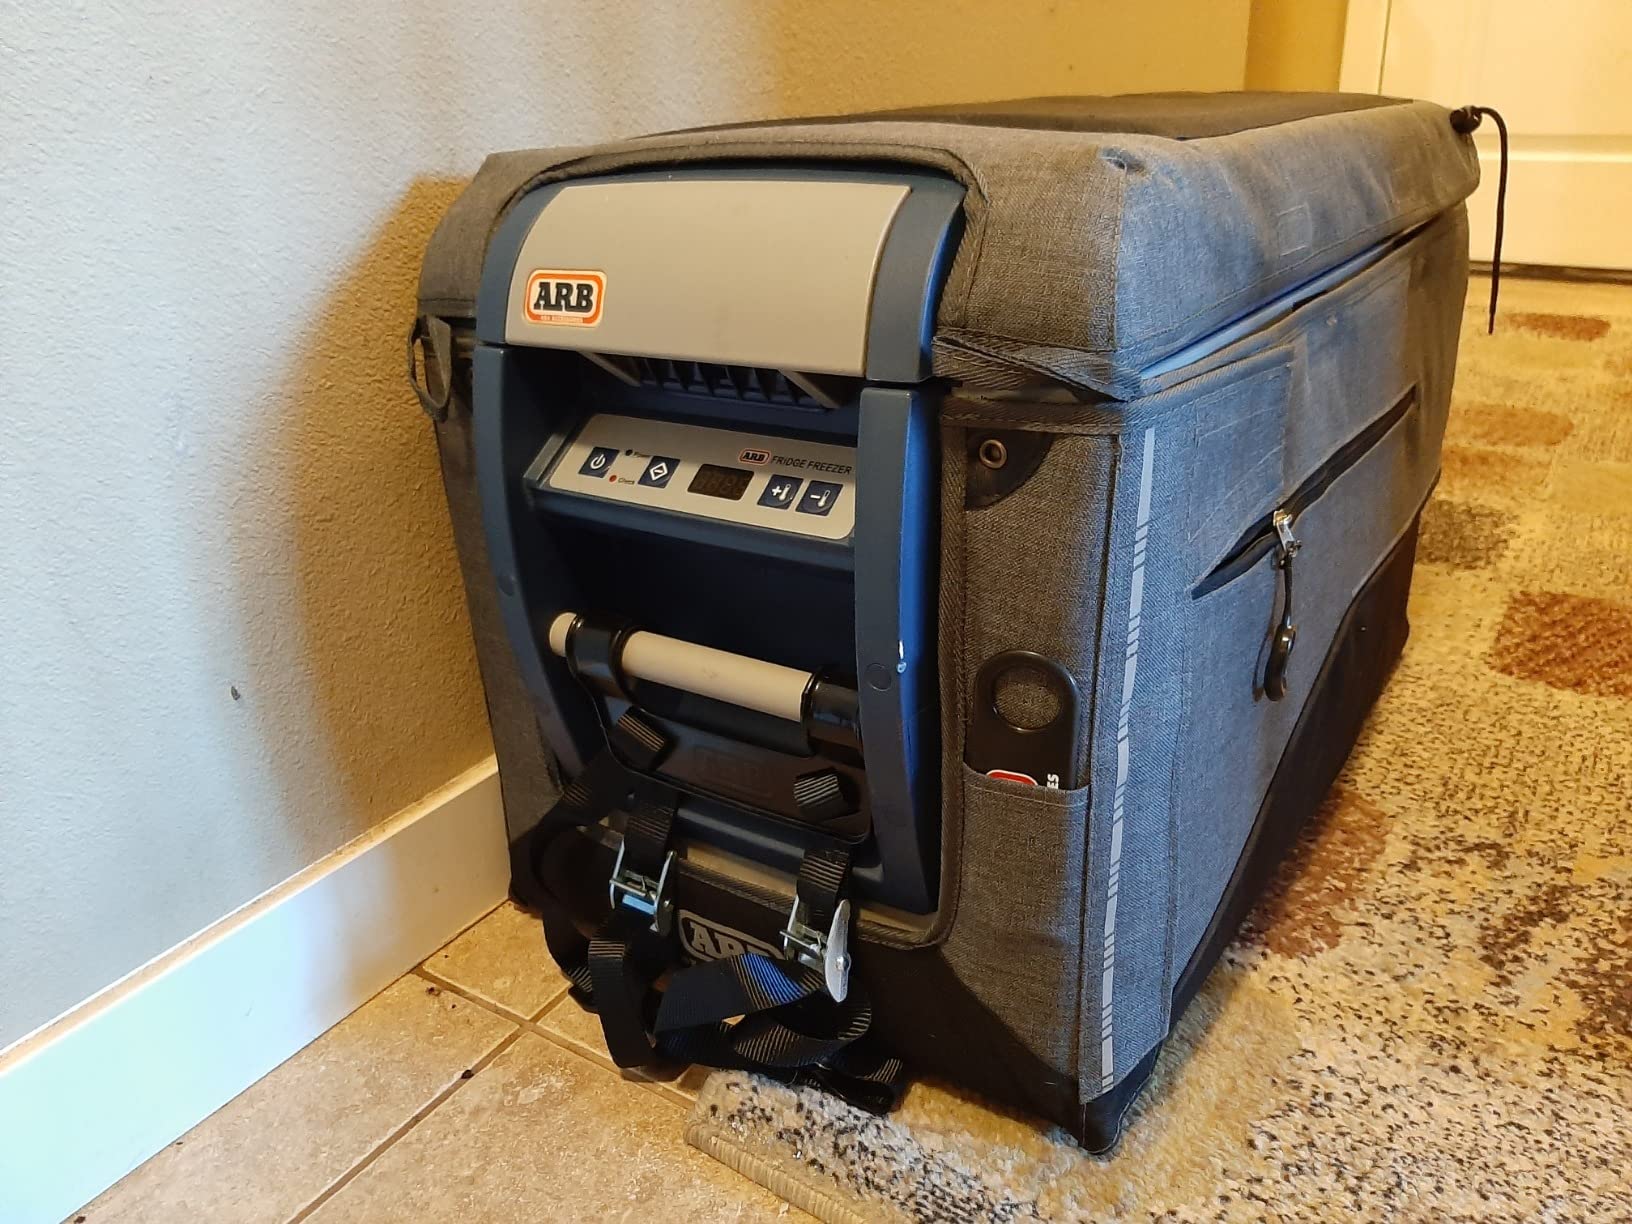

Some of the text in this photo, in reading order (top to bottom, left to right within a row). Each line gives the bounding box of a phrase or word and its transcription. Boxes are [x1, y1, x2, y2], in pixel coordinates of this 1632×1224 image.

[534, 281, 593, 313] ARB
[742, 451, 853, 475] ARB FRIDGE FREEZER
[689, 921, 771, 959] AR
